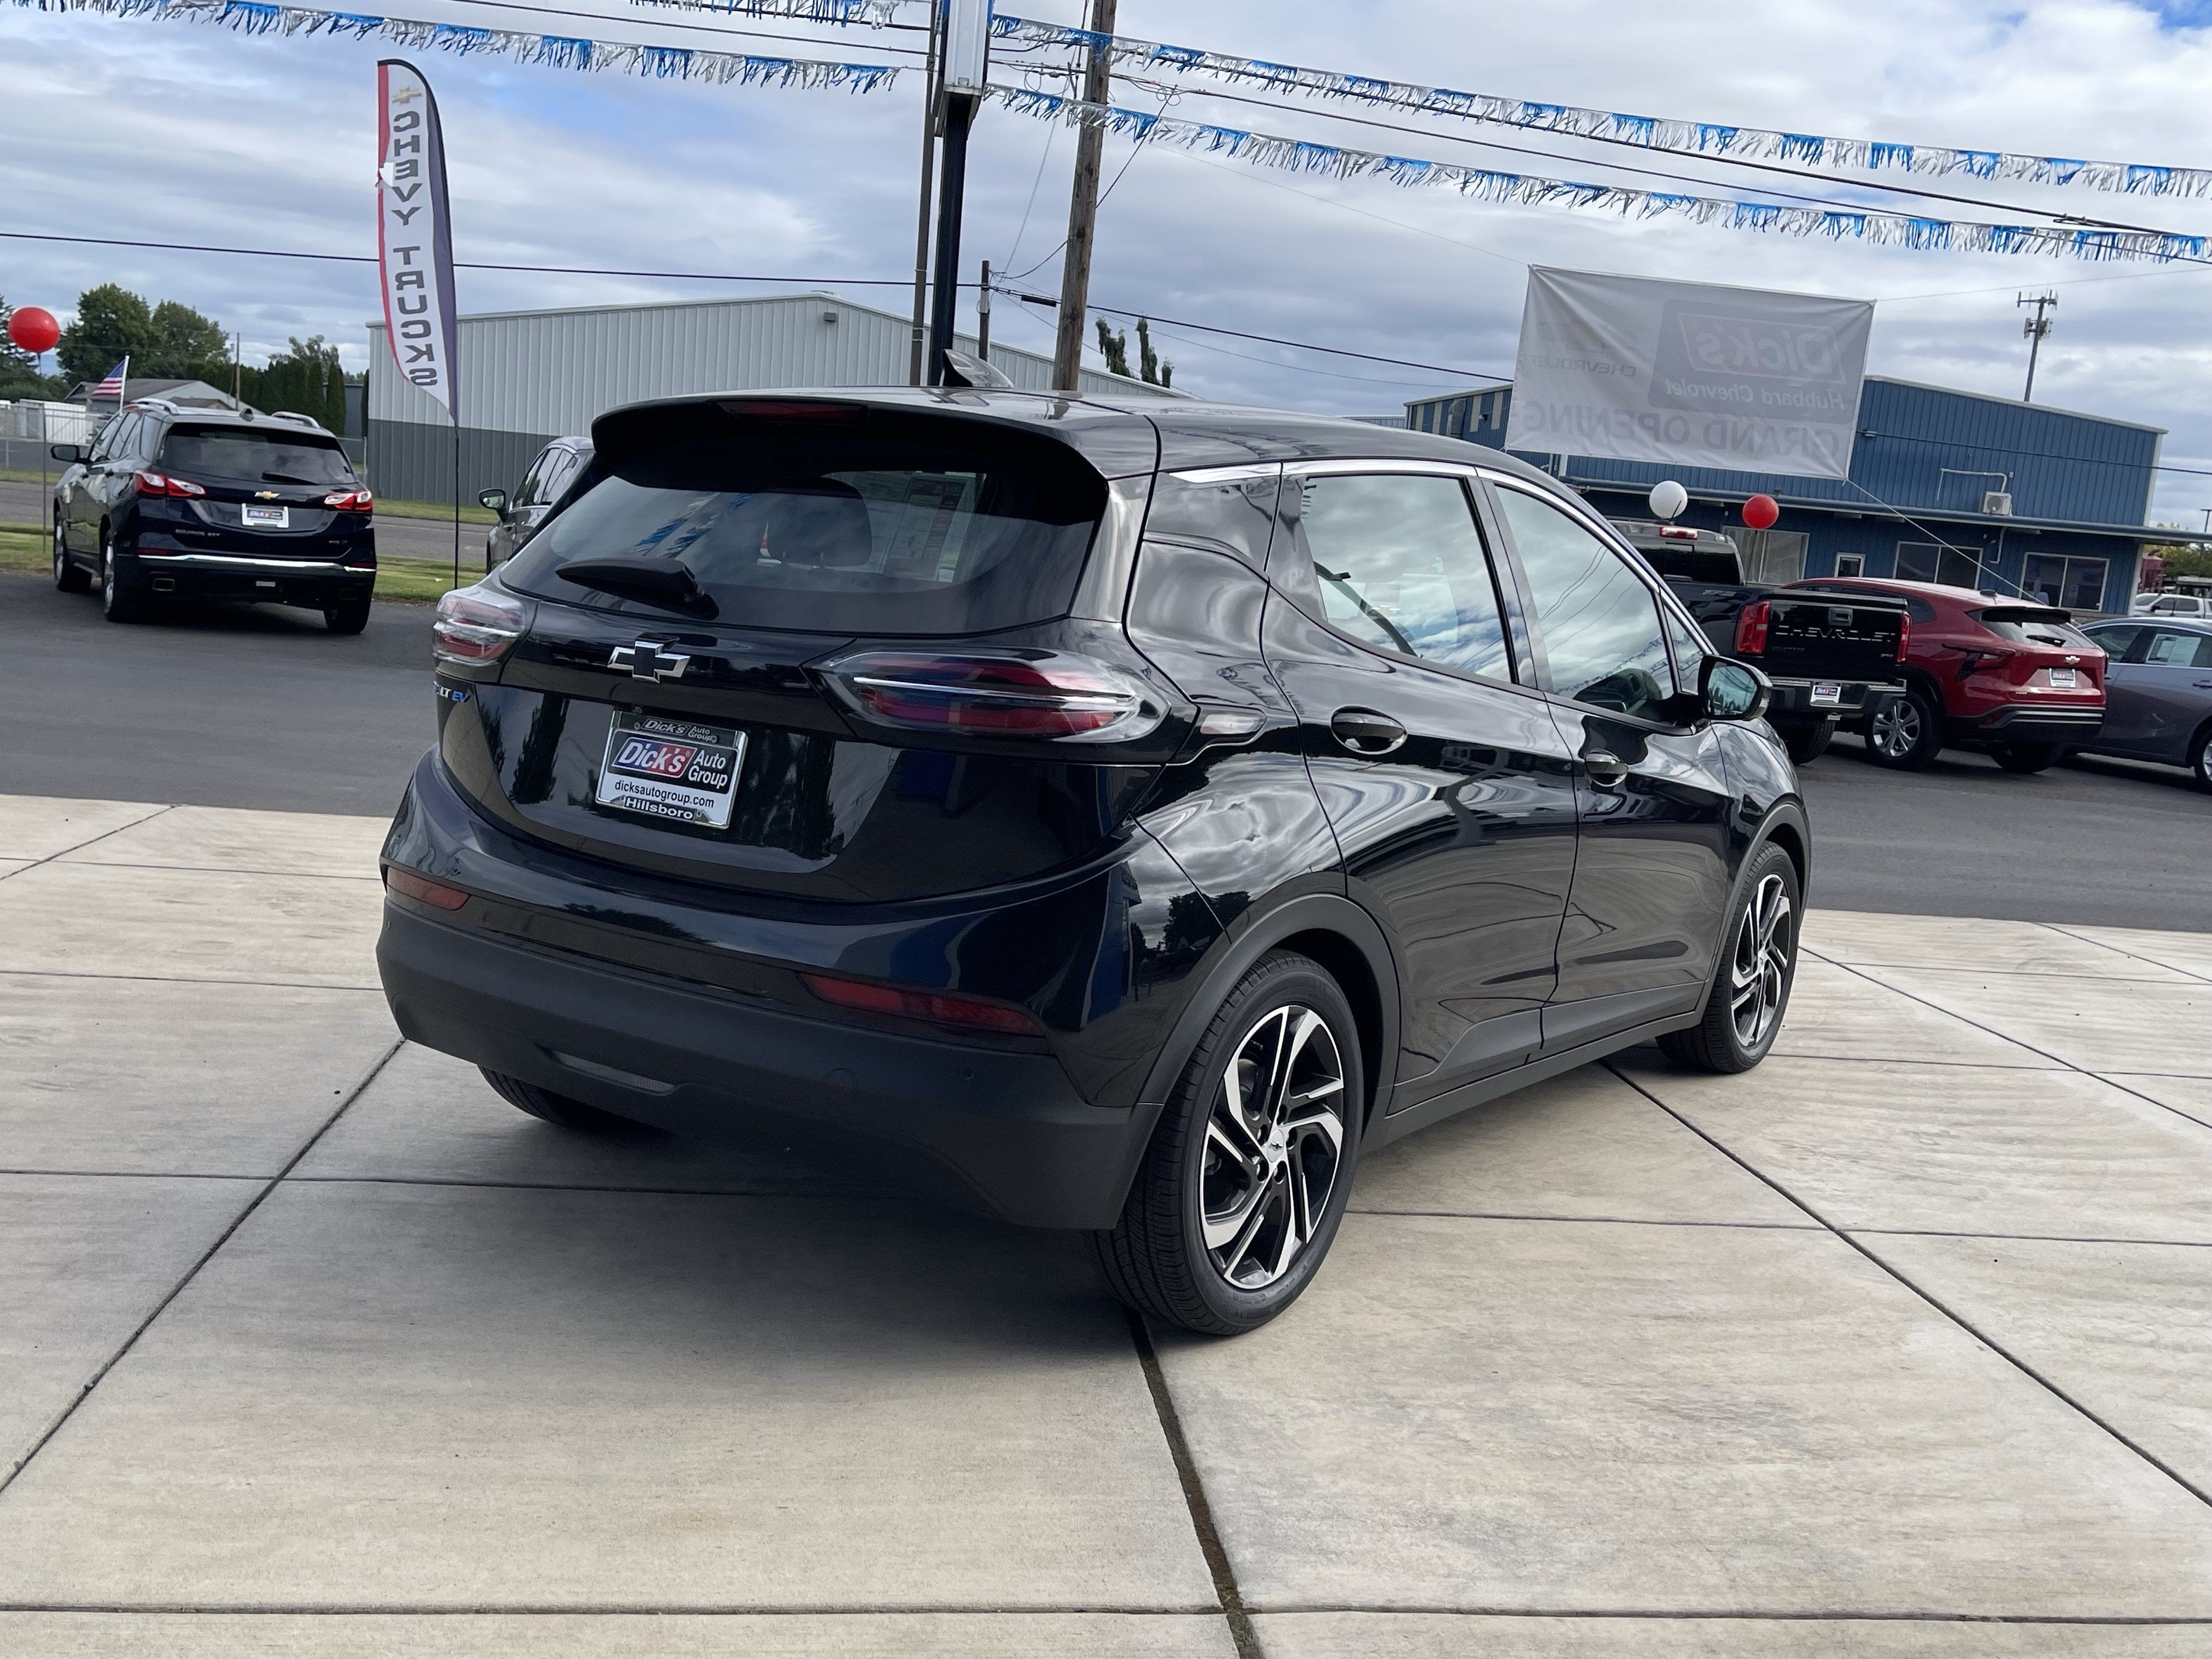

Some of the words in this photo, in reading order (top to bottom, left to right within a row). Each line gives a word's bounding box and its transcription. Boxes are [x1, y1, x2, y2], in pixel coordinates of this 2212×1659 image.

[645, 719, 686, 735] Dick's
[688, 731, 713, 742] Group
[691, 726, 710, 735] Auto
[618, 742, 686, 772] Dick's
[693, 750, 726, 769] Auto
[688, 765, 728, 789] Group
[615, 780, 714, 808] dicksautogroup.com
[625, 797, 693, 819] Hillsboro
